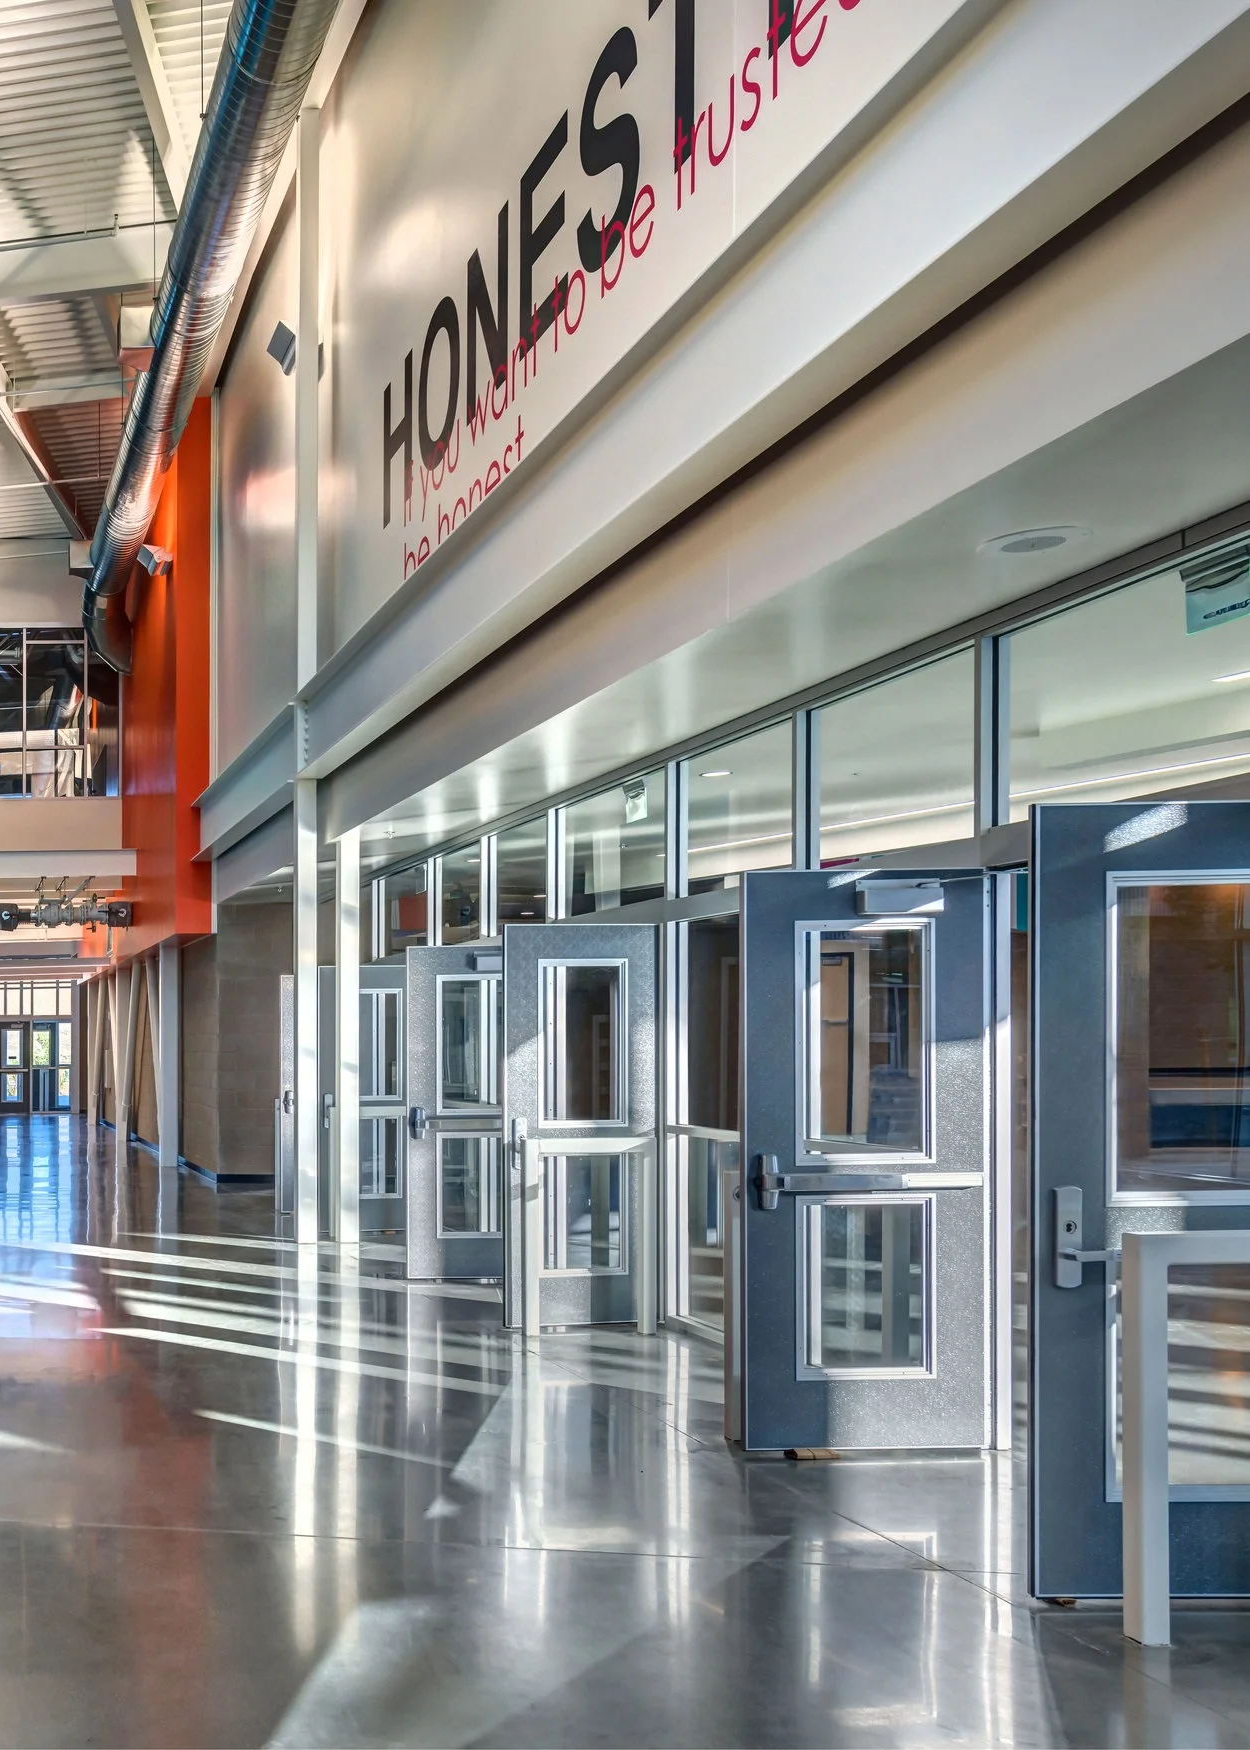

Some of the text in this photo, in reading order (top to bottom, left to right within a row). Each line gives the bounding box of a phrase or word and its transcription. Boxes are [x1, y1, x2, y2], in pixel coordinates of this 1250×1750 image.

[383, 0, 795, 530] HONEST
[419, 418, 460, 522] you
[467, 302, 541, 447] want
[551, 269, 586, 353] to
[600, 184, 656, 299] be
